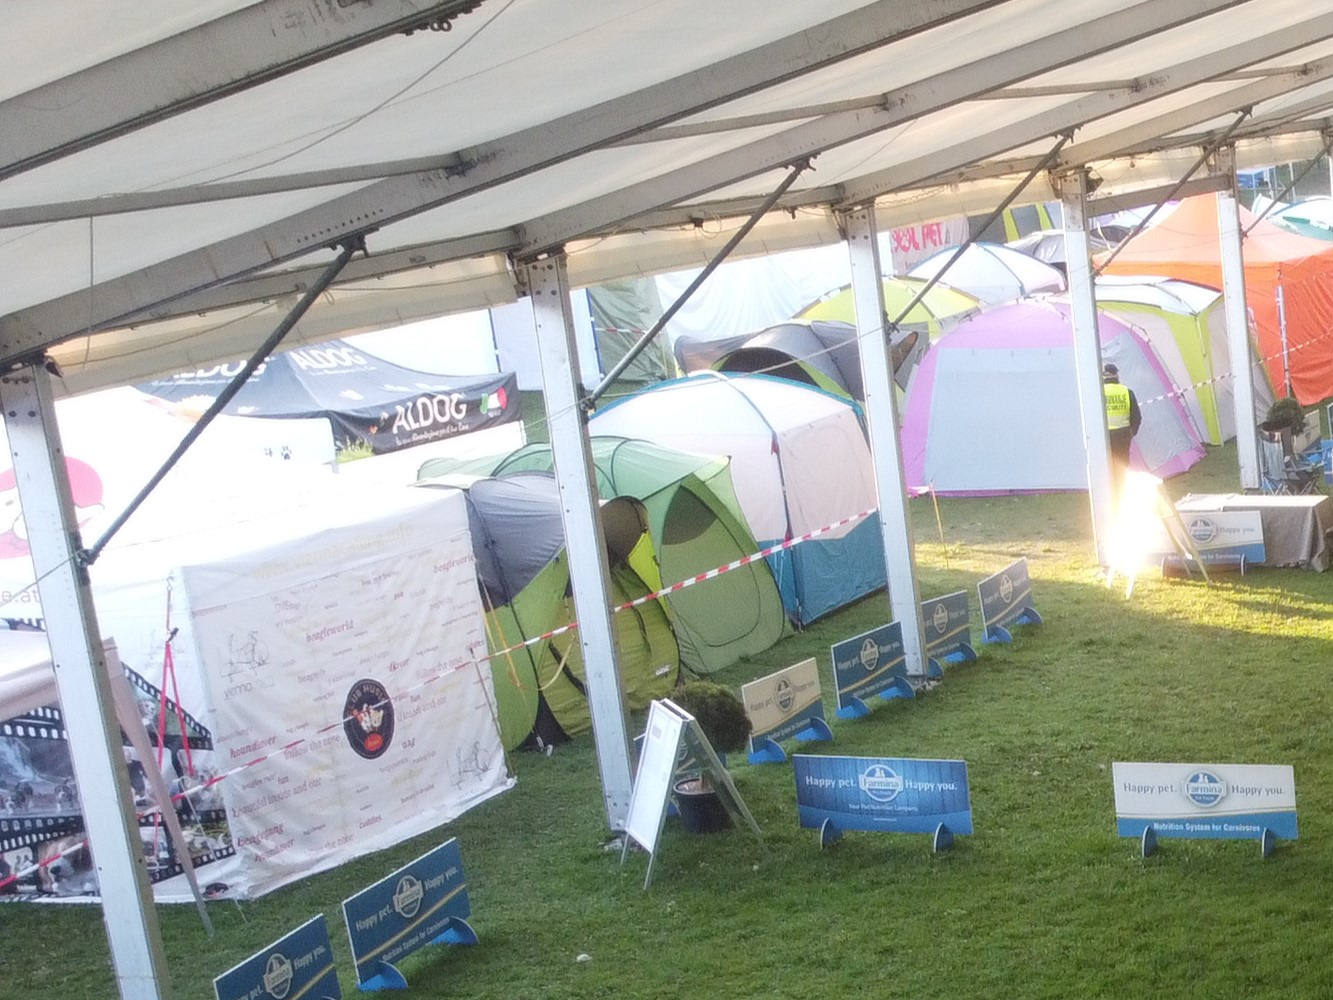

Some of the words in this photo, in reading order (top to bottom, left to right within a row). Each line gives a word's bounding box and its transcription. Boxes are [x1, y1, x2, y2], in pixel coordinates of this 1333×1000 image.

[392, 391, 469, 435] ALDOG
[805, 775, 835, 788] Happy
[905, 779, 936, 792] Happy
[1123, 783, 1154, 794] Happy
[1231, 784, 1264, 795] Happy
